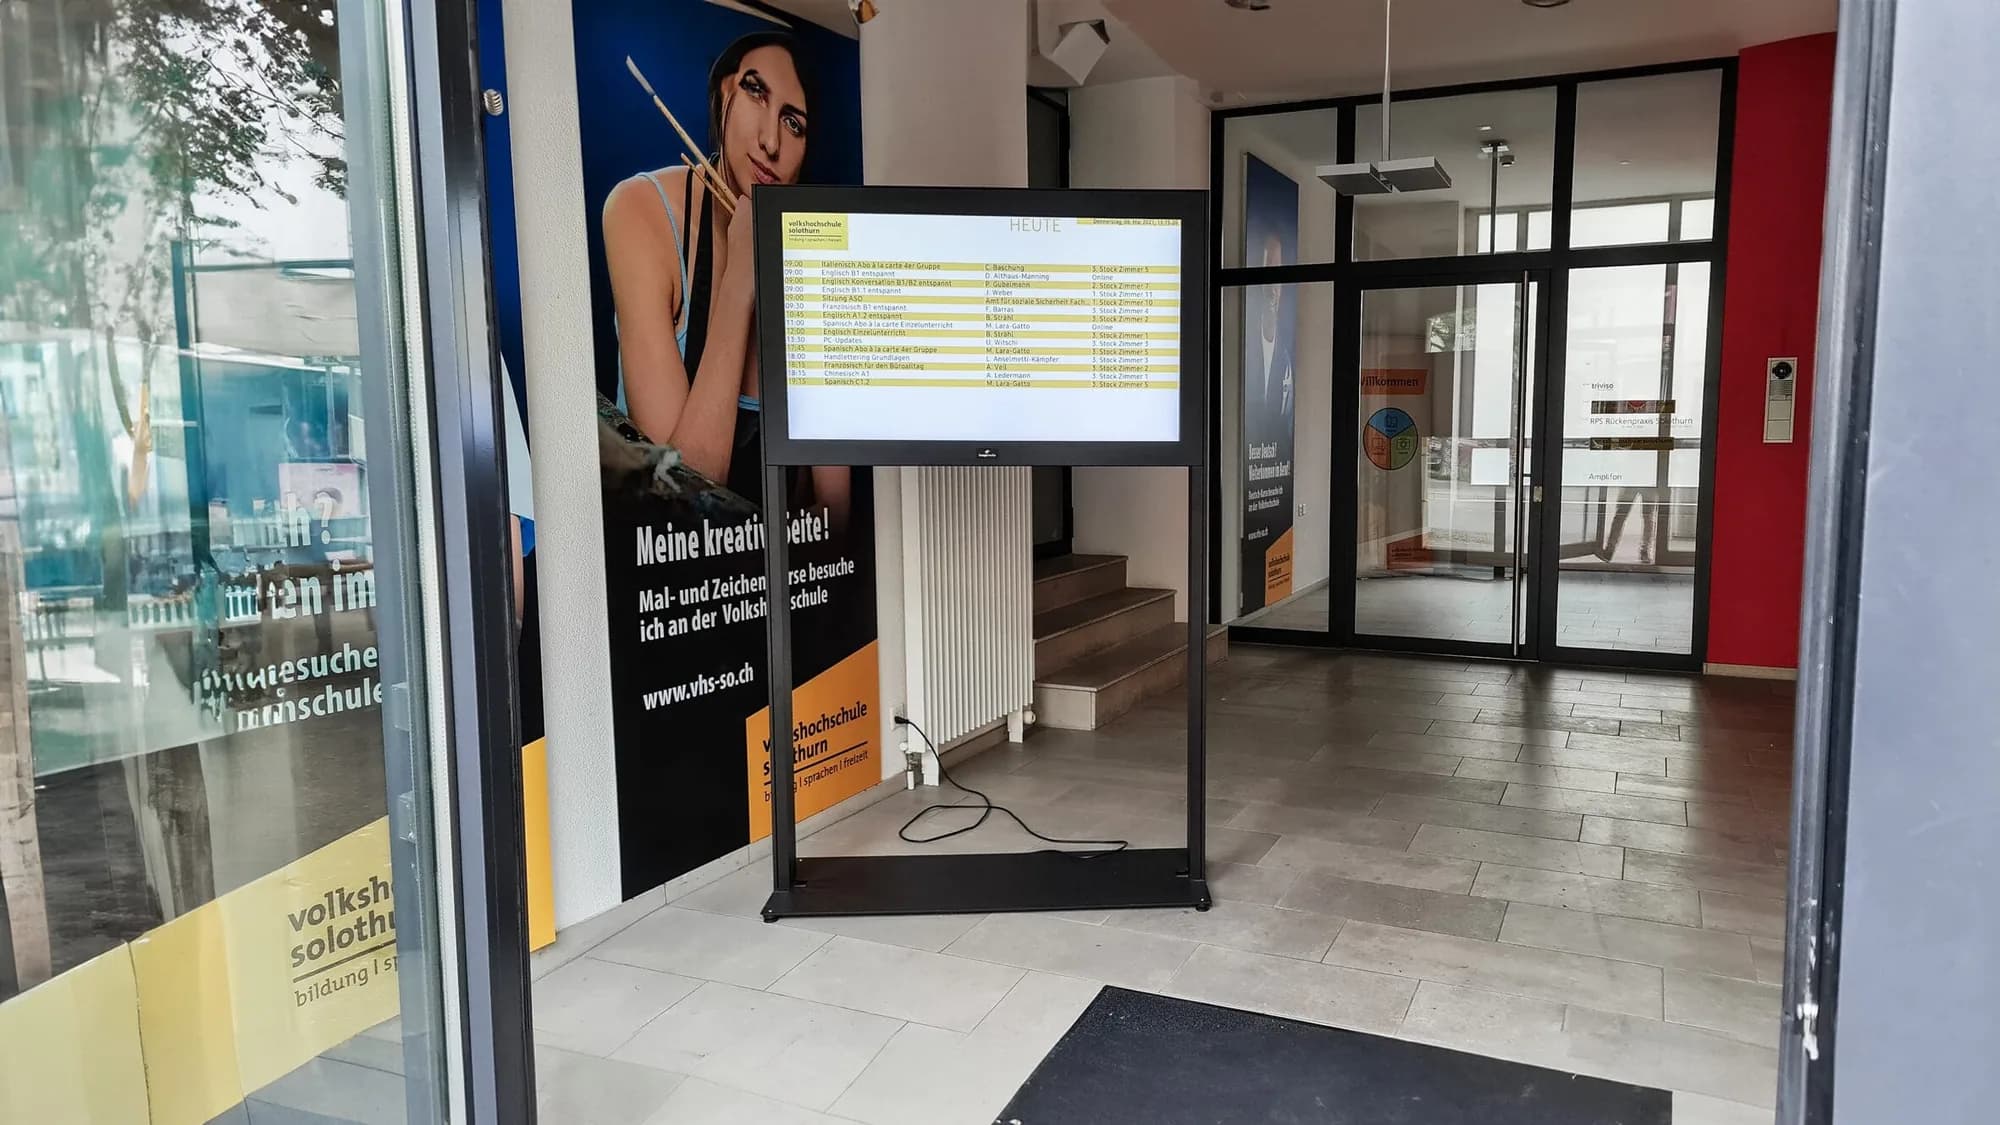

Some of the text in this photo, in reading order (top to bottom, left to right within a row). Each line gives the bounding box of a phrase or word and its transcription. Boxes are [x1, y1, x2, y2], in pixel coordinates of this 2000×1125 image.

[1010, 218, 1062, 232] HEUTE
[916, 262, 940, 271] Gruppe
[992, 264, 1024, 273] Baschung
[822, 269, 849, 278] Englisch
[862, 270, 895, 279] entspannt
[993, 273, 1050, 281] Althaus-Manning
[822, 278, 849, 286] Englisch
[919, 279, 952, 288] entspannt
[822, 286, 850, 295] Englisch
[868, 287, 901, 295] entspannt
[822, 294, 847, 303] Sitzung
[873, 304, 906, 312] entspannt
[822, 311, 850, 320] Englisch
[868, 312, 902, 320] entspannt
[823, 320, 852, 328] Spanisch
[823, 328, 851, 337] Englisch
[823, 345, 853, 353] Spanisch
[914, 346, 937, 354] Gruppe
[824, 353, 910, 362] Handlettering Grundlagen
[824, 378, 854, 387] Spanisch
[1592, 382, 1614, 390] triviso
[1606, 417, 1654, 426] Rückenpraxis
[636, 522, 699, 566] Meine
[639, 586, 676, 613] Mal-
[679, 580, 709, 606] und
[809, 557, 854, 581] besuche
[640, 617, 664, 642] ich
[668, 616, 688, 636] an
[692, 609, 717, 631] der
[643, 662, 754, 711] www.vhs-so.ch
[804, 750, 868, 788] sprachen freizeit
[294, 967, 368, 1008] bildung
